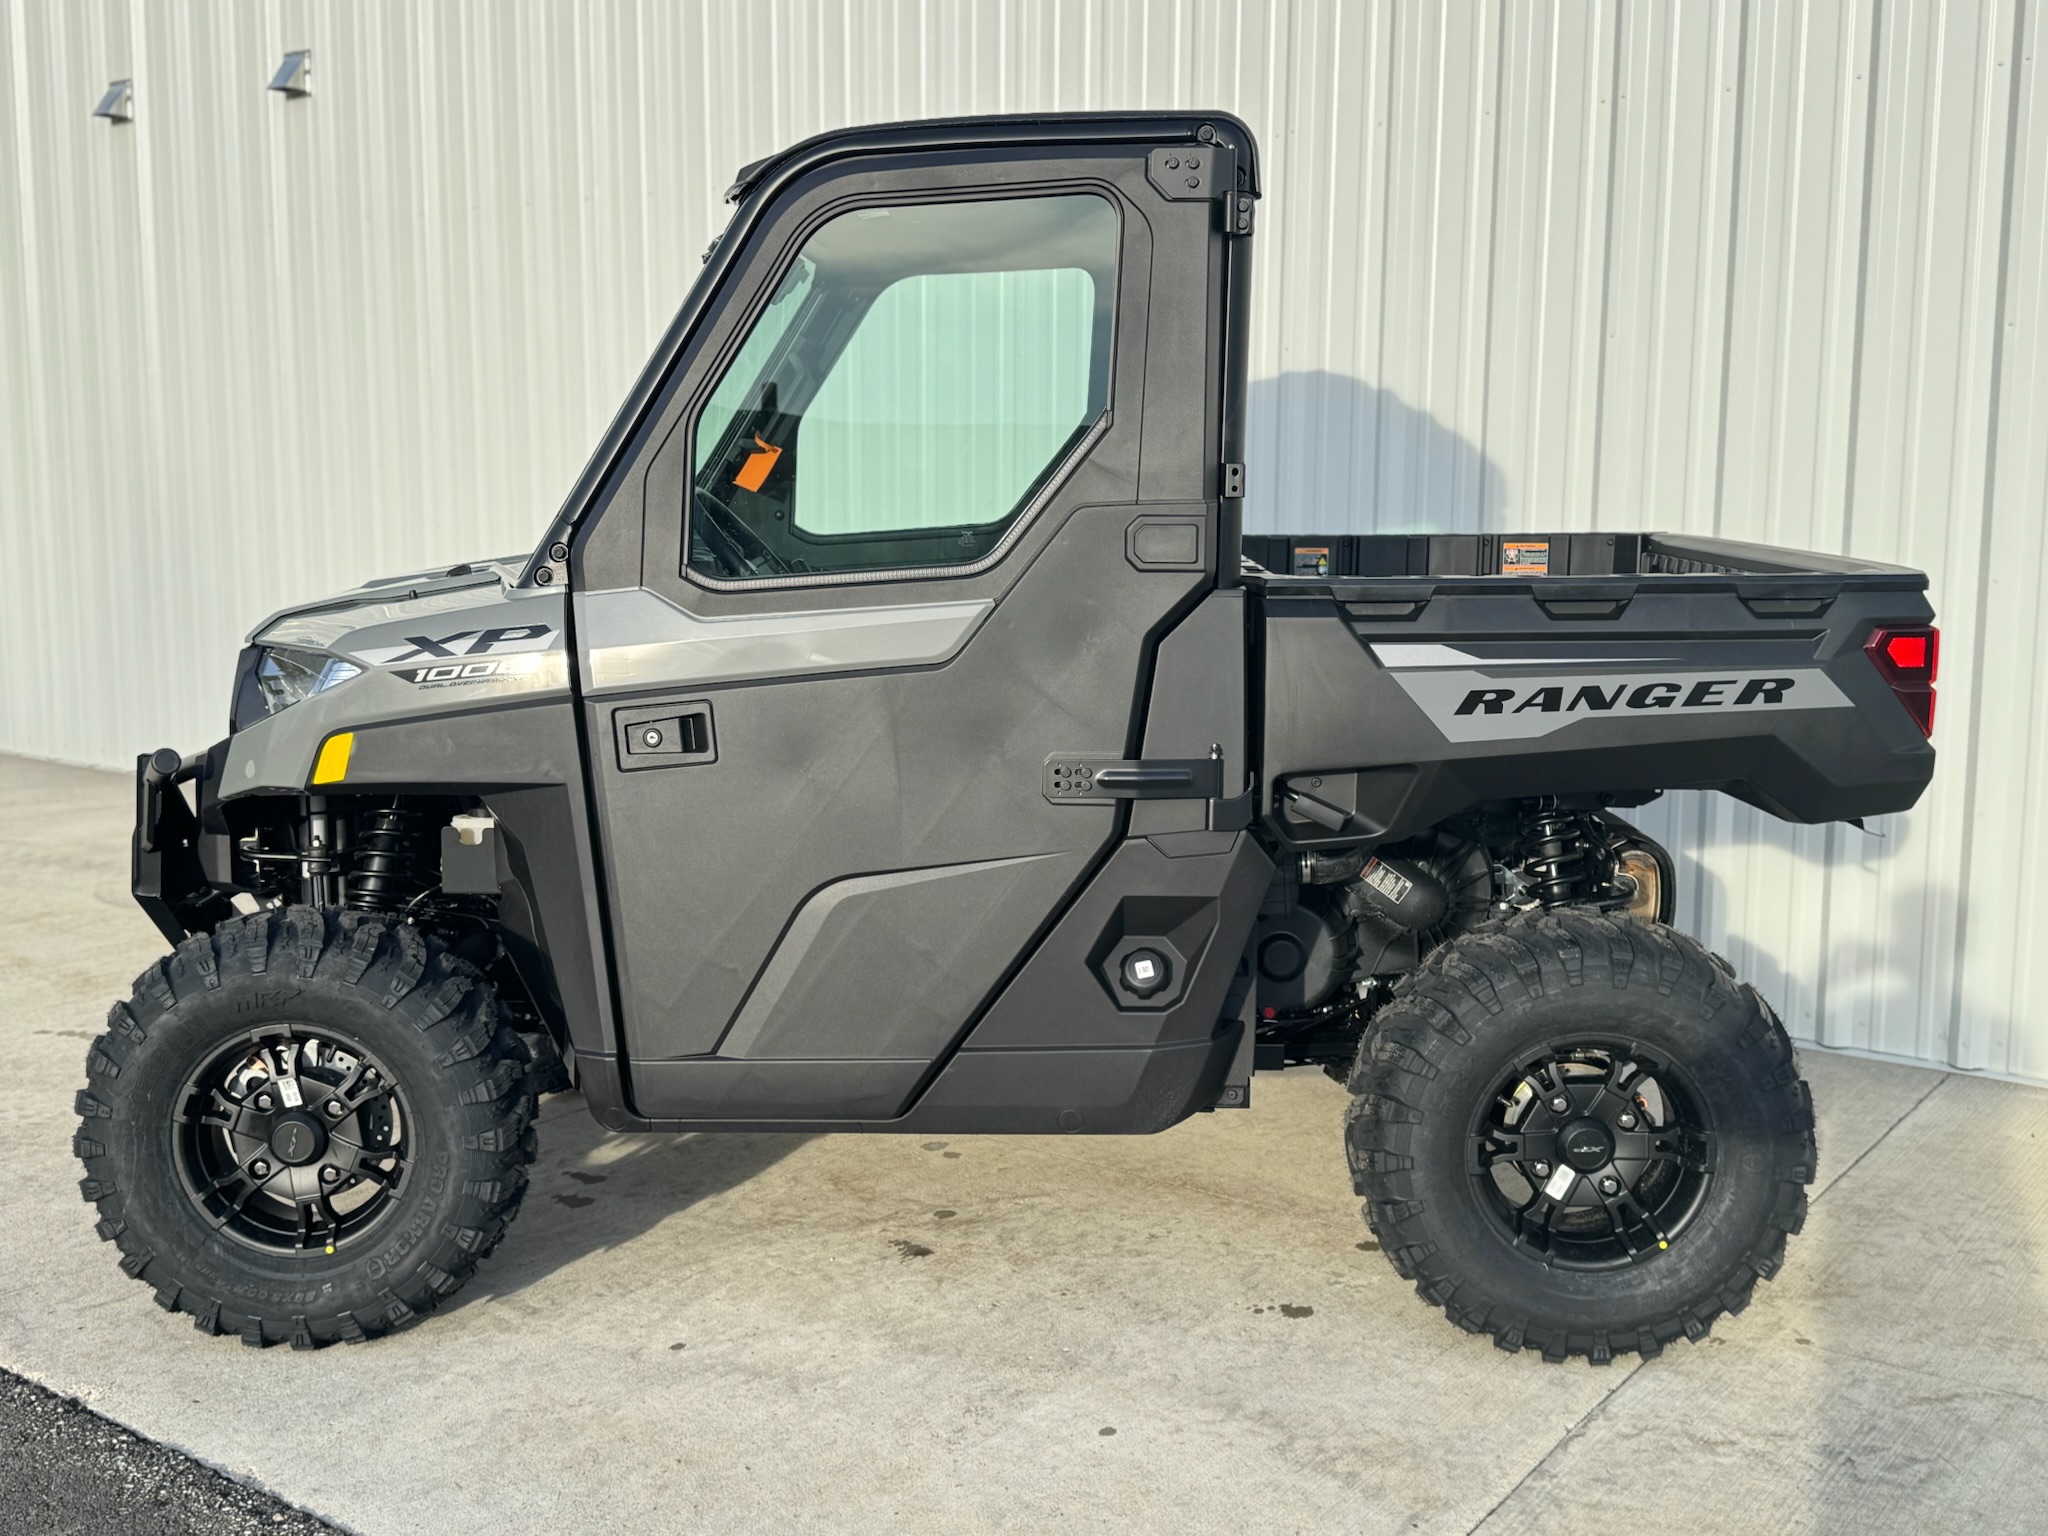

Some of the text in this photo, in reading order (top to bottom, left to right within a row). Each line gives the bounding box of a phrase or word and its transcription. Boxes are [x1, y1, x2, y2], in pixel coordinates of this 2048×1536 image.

[381, 624, 552, 663] XP
[1453, 677, 1796, 716] RANGER
[383, 1196, 438, 1264] ARMOR
